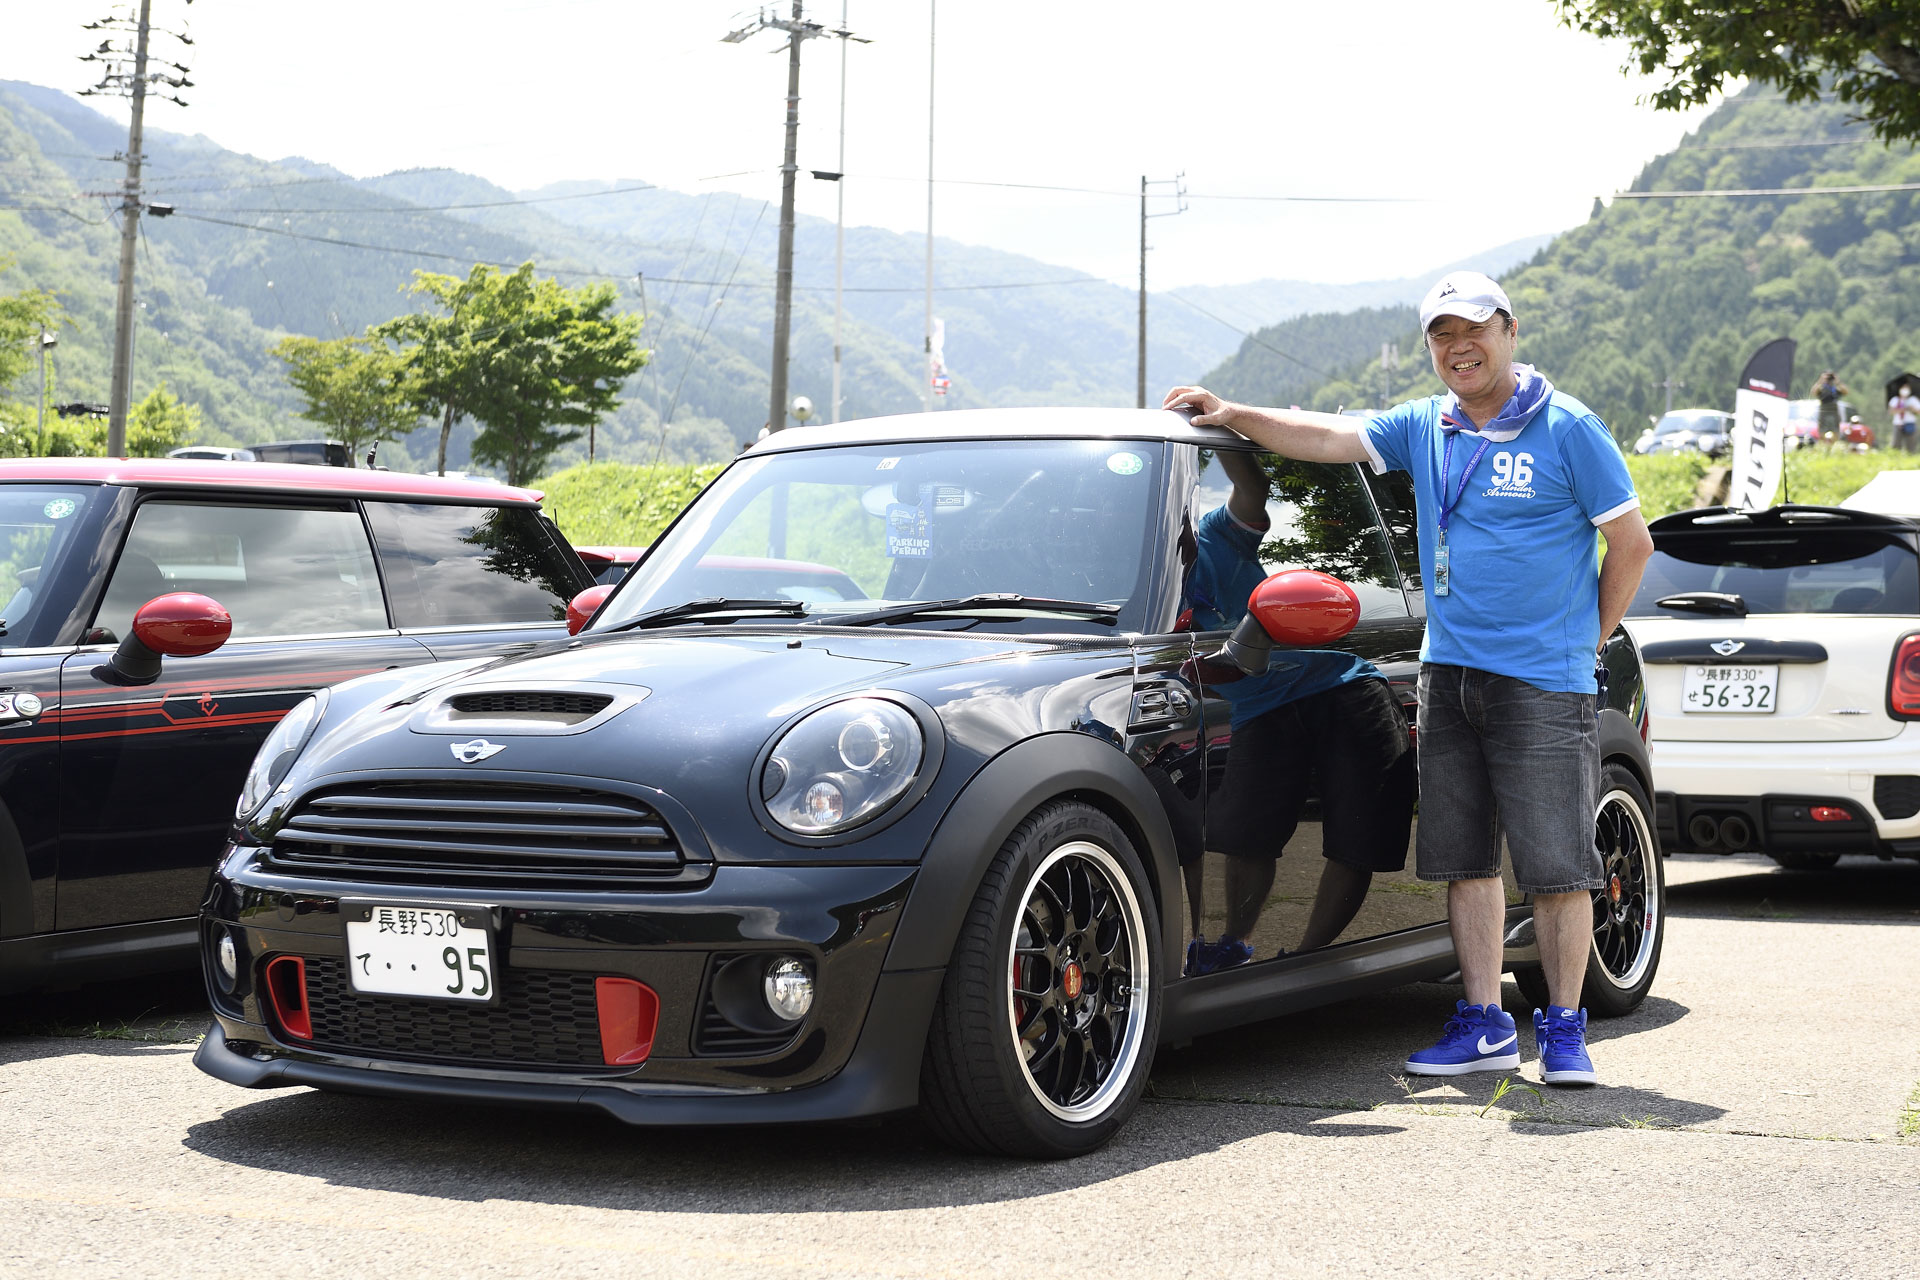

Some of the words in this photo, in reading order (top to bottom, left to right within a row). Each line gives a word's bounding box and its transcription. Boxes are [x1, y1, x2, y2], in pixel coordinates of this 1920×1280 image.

[1491, 451, 1534, 487] 96
[1501, 481, 1532, 492] Under
[1482, 487, 1536, 498] Armour
[889, 536, 930, 547] PARKING
[891, 546, 927, 556] PERMIT
[1688, 690, 1698, 702] せ
[1702, 684, 1771, 708] 56-32
[355, 952, 372, 977] て
[442, 946, 489, 997] 95
